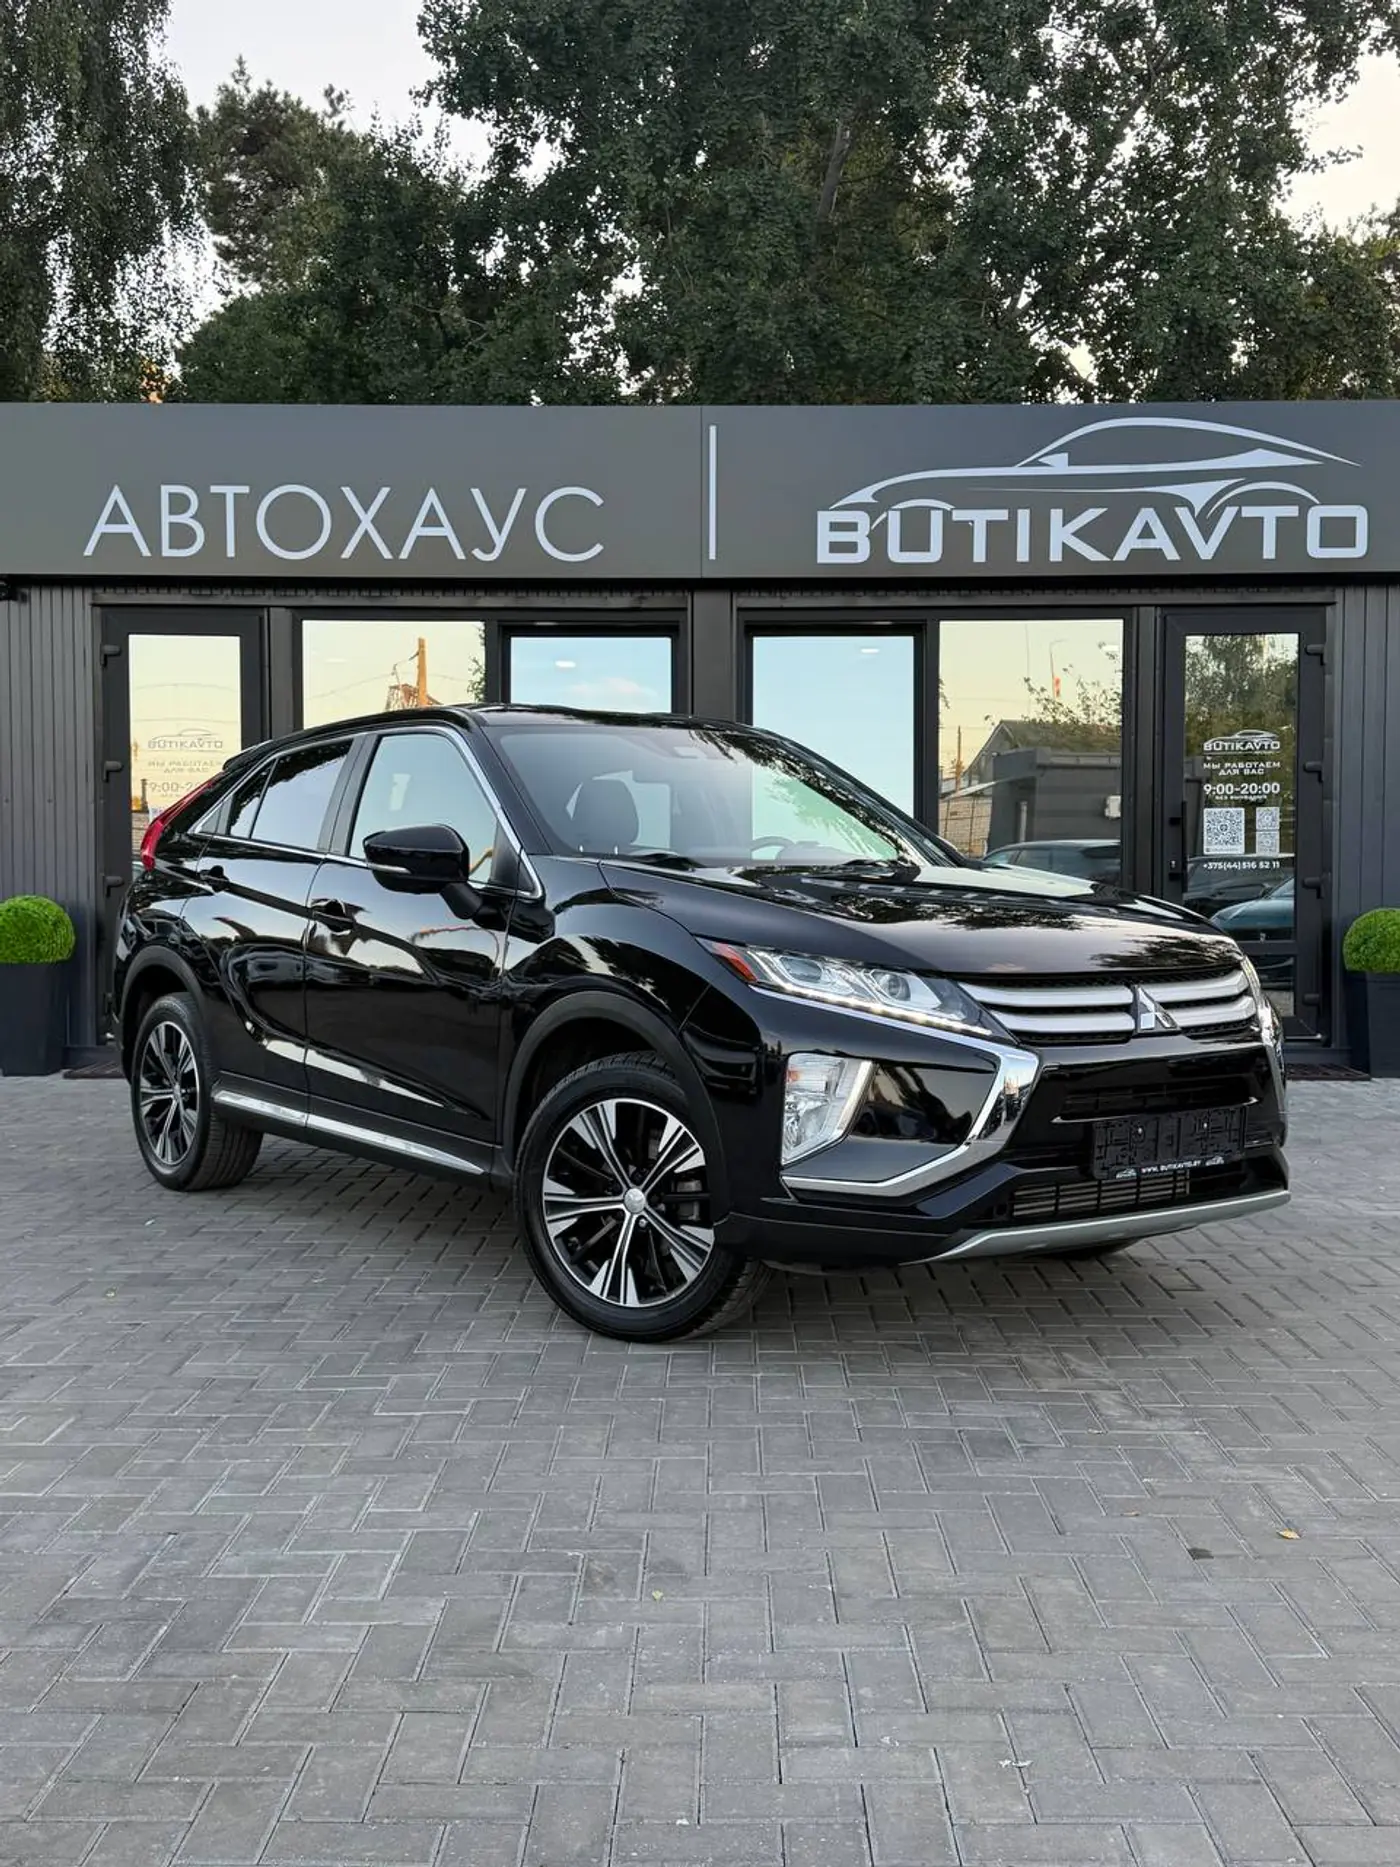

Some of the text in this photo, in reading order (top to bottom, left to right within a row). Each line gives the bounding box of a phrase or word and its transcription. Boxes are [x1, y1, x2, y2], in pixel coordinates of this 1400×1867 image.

[83, 483, 606, 563] АВТОХАУС
[816, 504, 1370, 565] BUTIKAVTO
[148, 740, 223, 749] BUTIKAVTO
[1203, 741, 1281, 751] BUTIKAVTO
[1224, 761, 1281, 769] РАБОТАЕМ
[1203, 782, 1281, 795] 9:00-20:00
